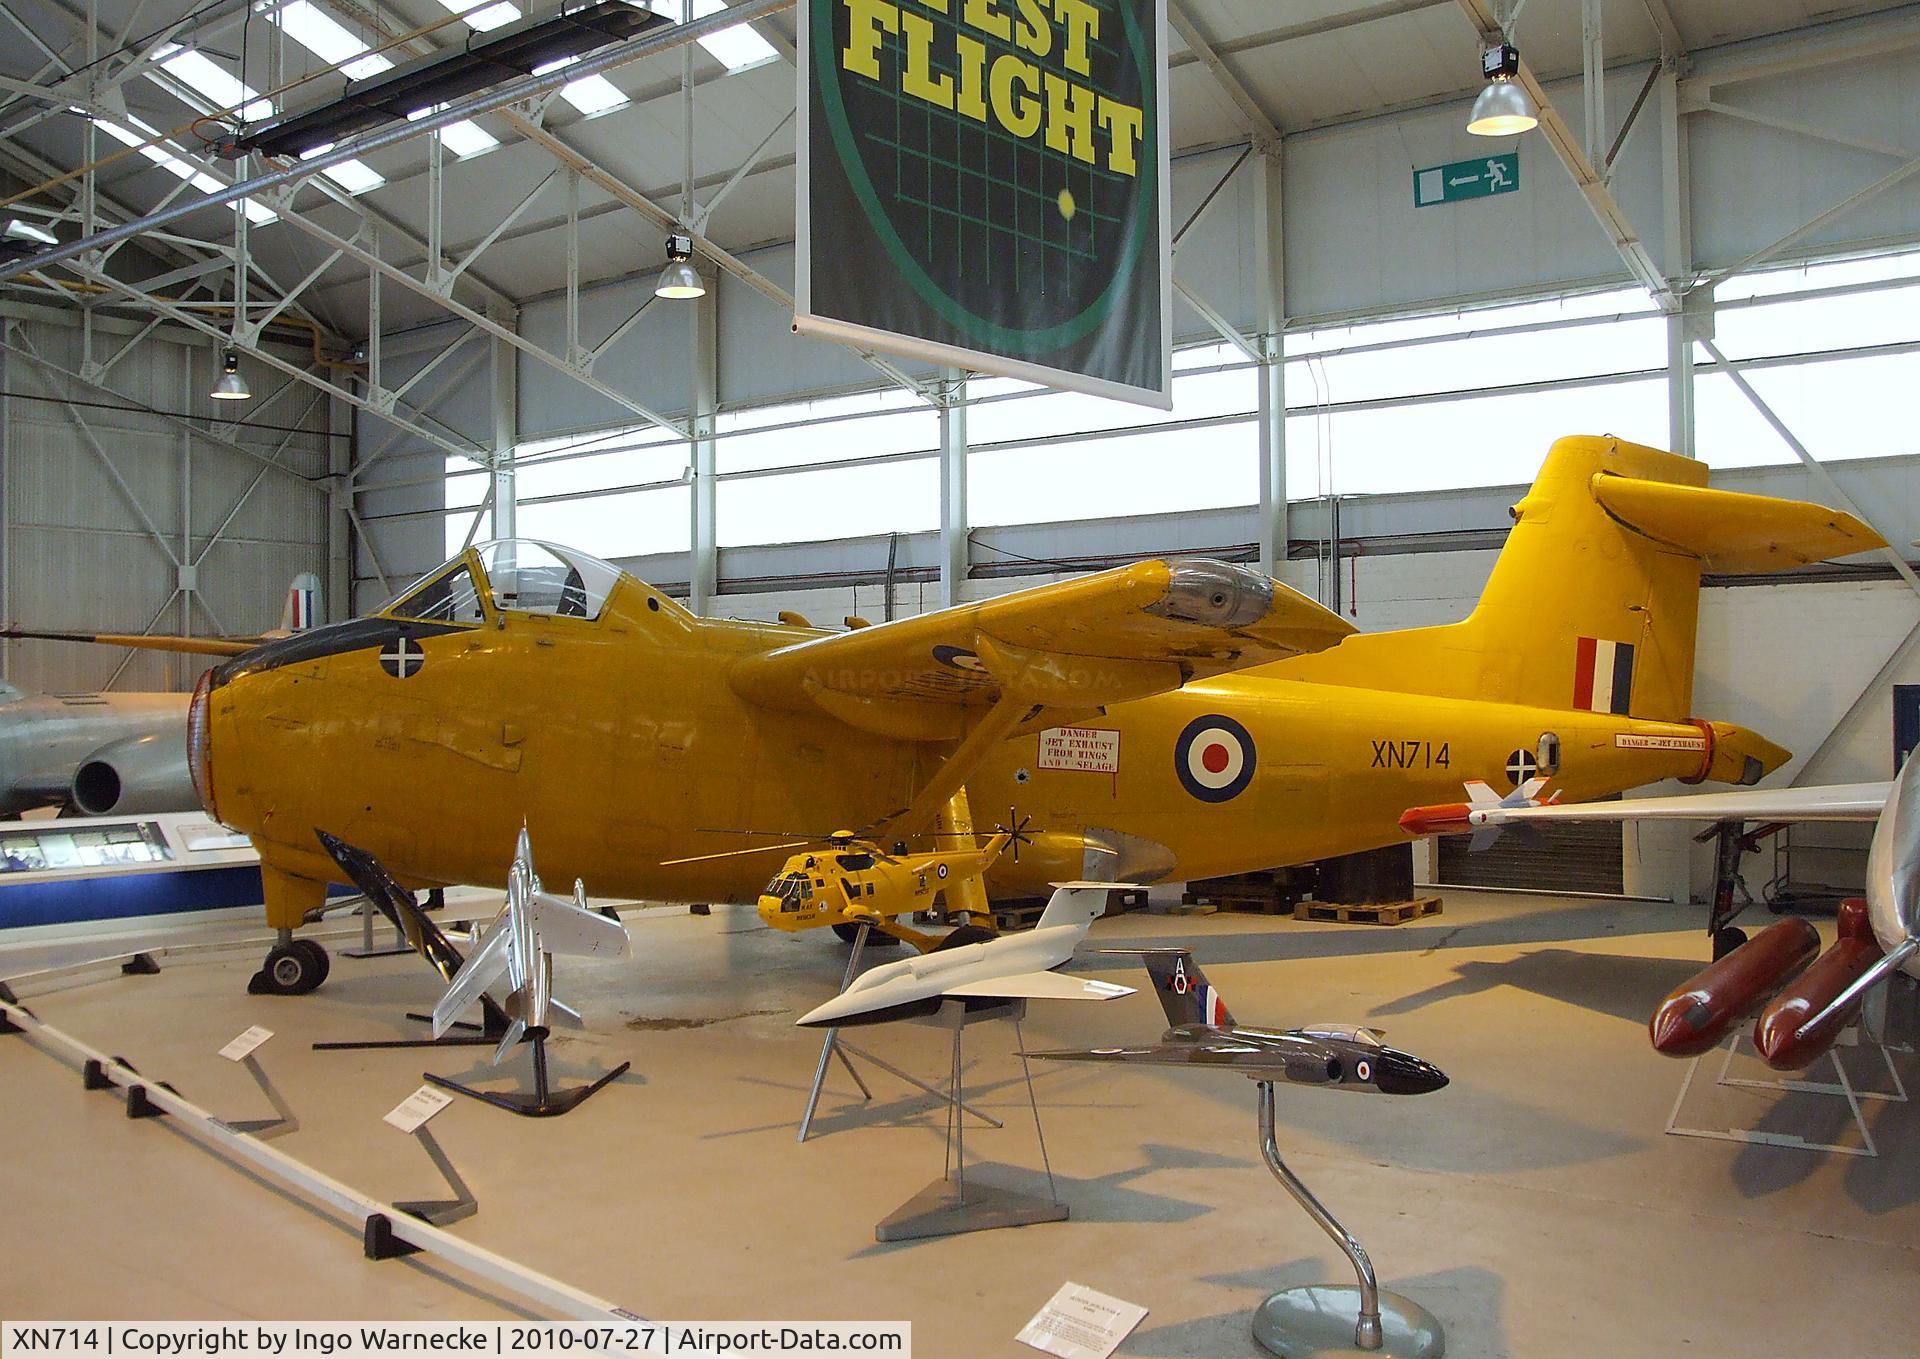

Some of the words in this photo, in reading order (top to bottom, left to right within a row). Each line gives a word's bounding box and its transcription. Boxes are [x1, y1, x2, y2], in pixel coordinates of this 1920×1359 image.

[843, 0, 1143, 177] FLIGHT
[1060, 729, 1097, 739] DANGER
[1045, 737, 1064, 747] JET
[1069, 739, 1113, 750] EXHAUST
[1621, 738, 1648, 746] DANGER
[1657, 739, 1671, 747] JET
[1047, 748, 1073, 758] FROM
[1078, 750, 1108, 760] WINGS
[1371, 740, 1450, 769] XN714
